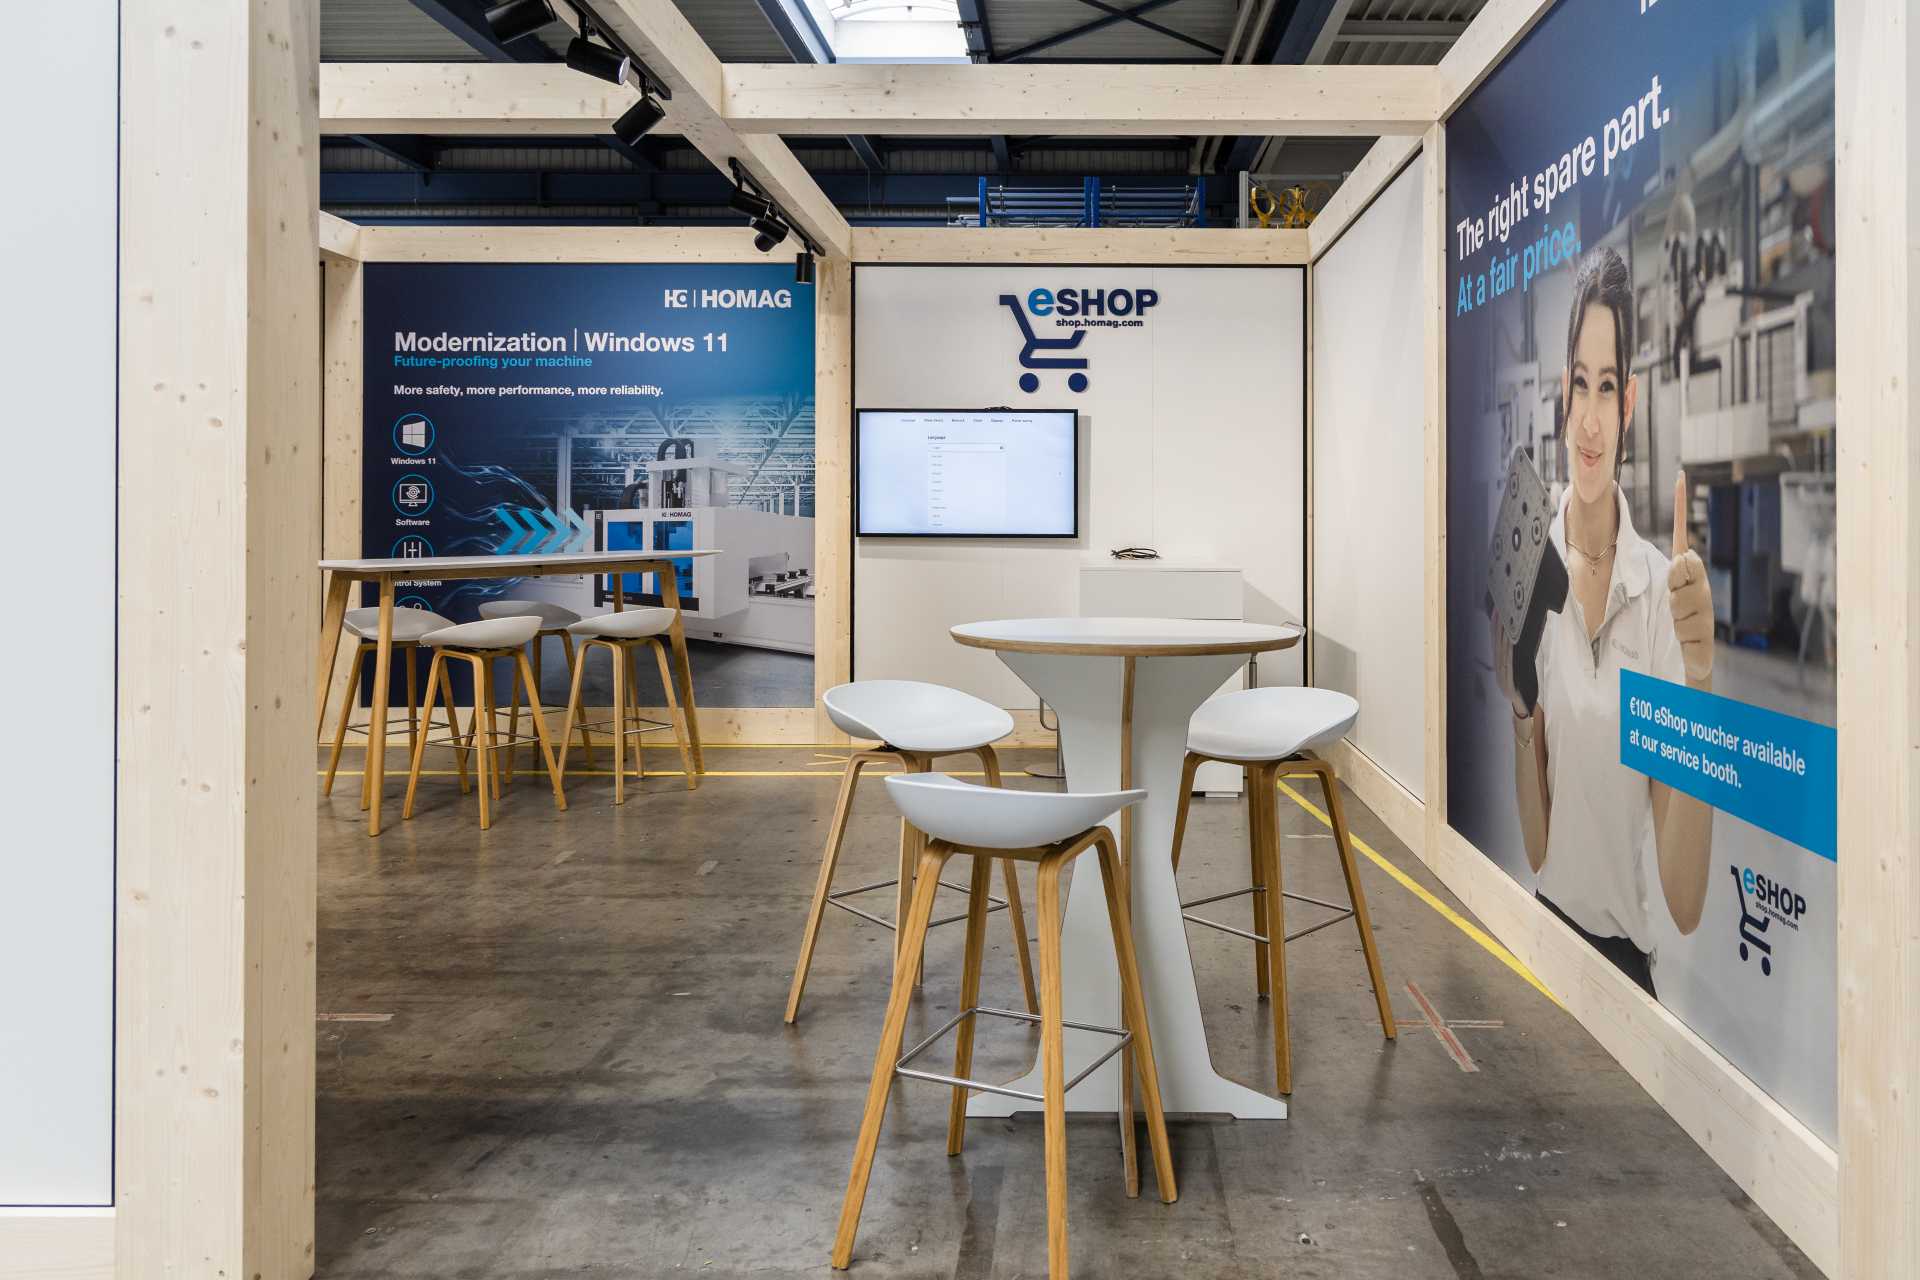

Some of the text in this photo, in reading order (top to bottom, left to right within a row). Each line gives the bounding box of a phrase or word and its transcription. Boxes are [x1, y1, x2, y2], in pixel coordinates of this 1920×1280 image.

[1456, 74, 1670, 261] The right spare part.
[1456, 221, 1582, 317] At a fair price.
[701, 289, 792, 308] HOMAG
[1027, 287, 1159, 317] eSHOP
[1055, 318, 1144, 328] shop.homag.com
[394, 331, 728, 353] Modernization Windows 11
[394, 355, 593, 369] Future-proofing your machine
[393, 384, 664, 397] More safety, more performance, more reliability.
[391, 457, 436, 465] Windows 11
[395, 518, 431, 526] Software
[1629, 696, 1806, 776] €100 eShop voucher available
[1629, 729, 1742, 789] at our service booth.
[1743, 867, 1807, 921] eSHOP
